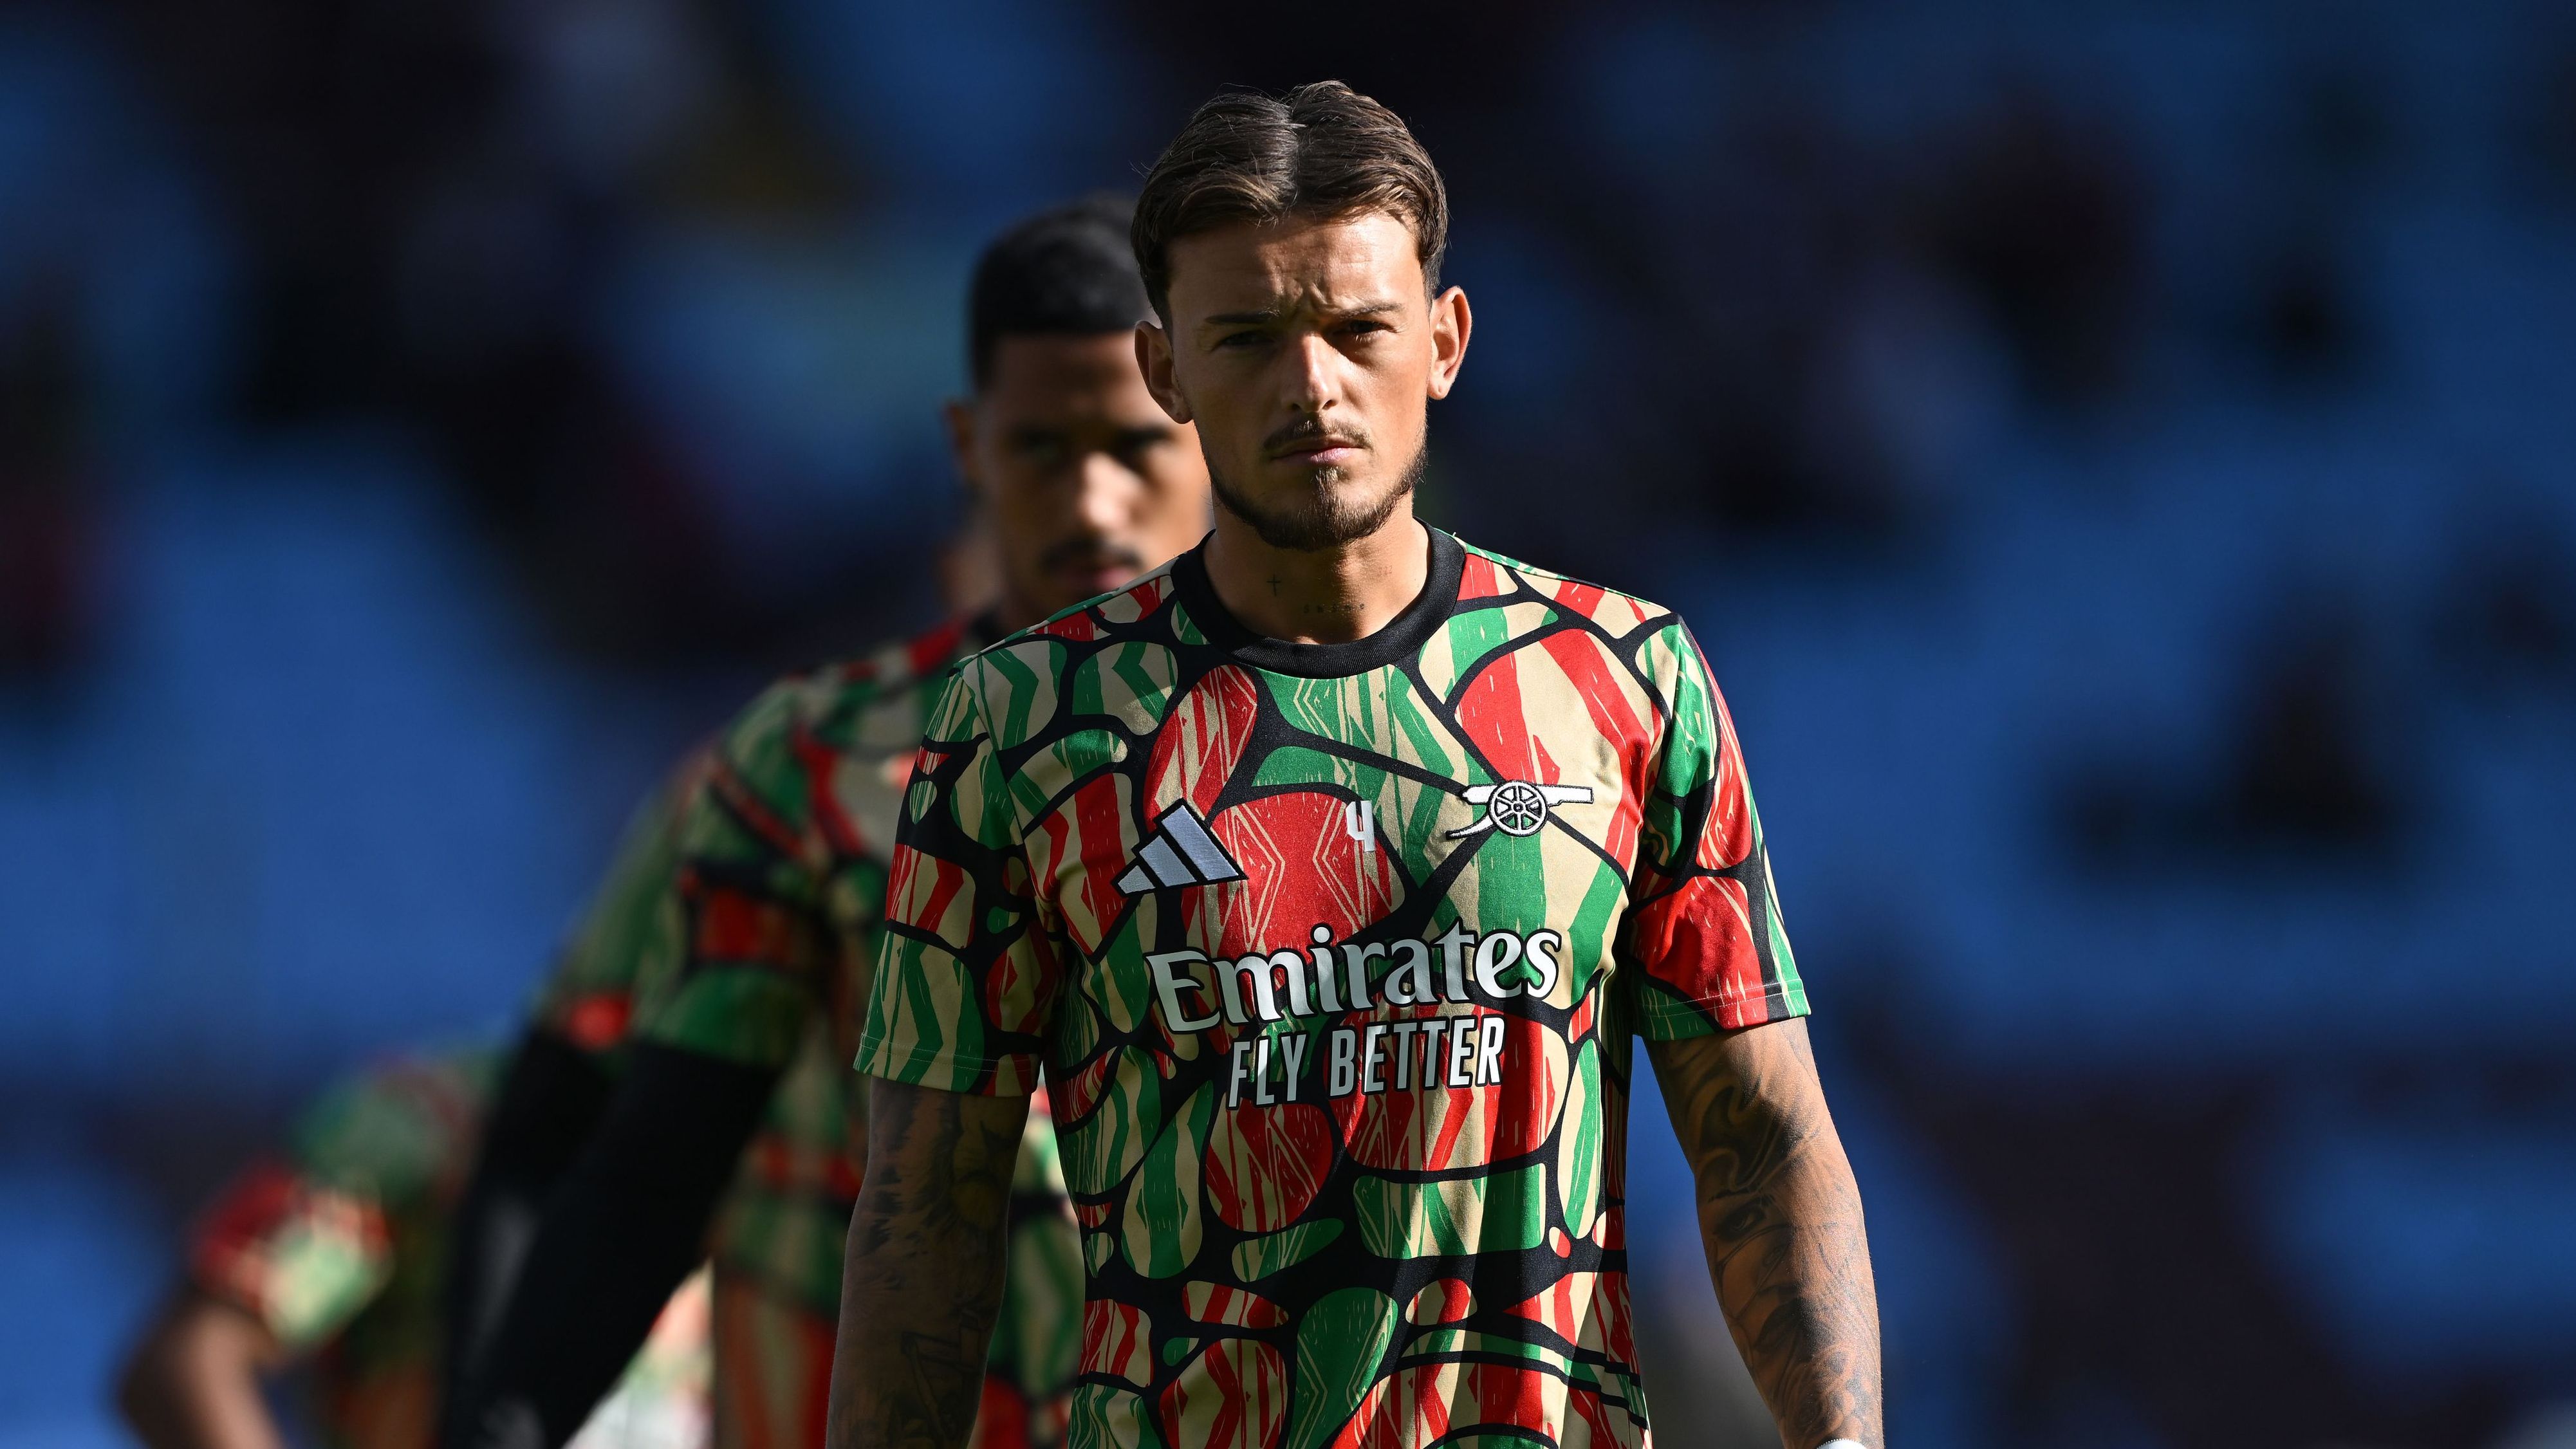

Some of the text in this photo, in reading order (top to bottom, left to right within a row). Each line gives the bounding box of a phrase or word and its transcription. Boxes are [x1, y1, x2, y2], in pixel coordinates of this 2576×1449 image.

[1346, 800, 1375, 852] 4
[1146, 920, 1561, 1032] Emirates
[1227, 1015, 1506, 1109] FLY BETTER
